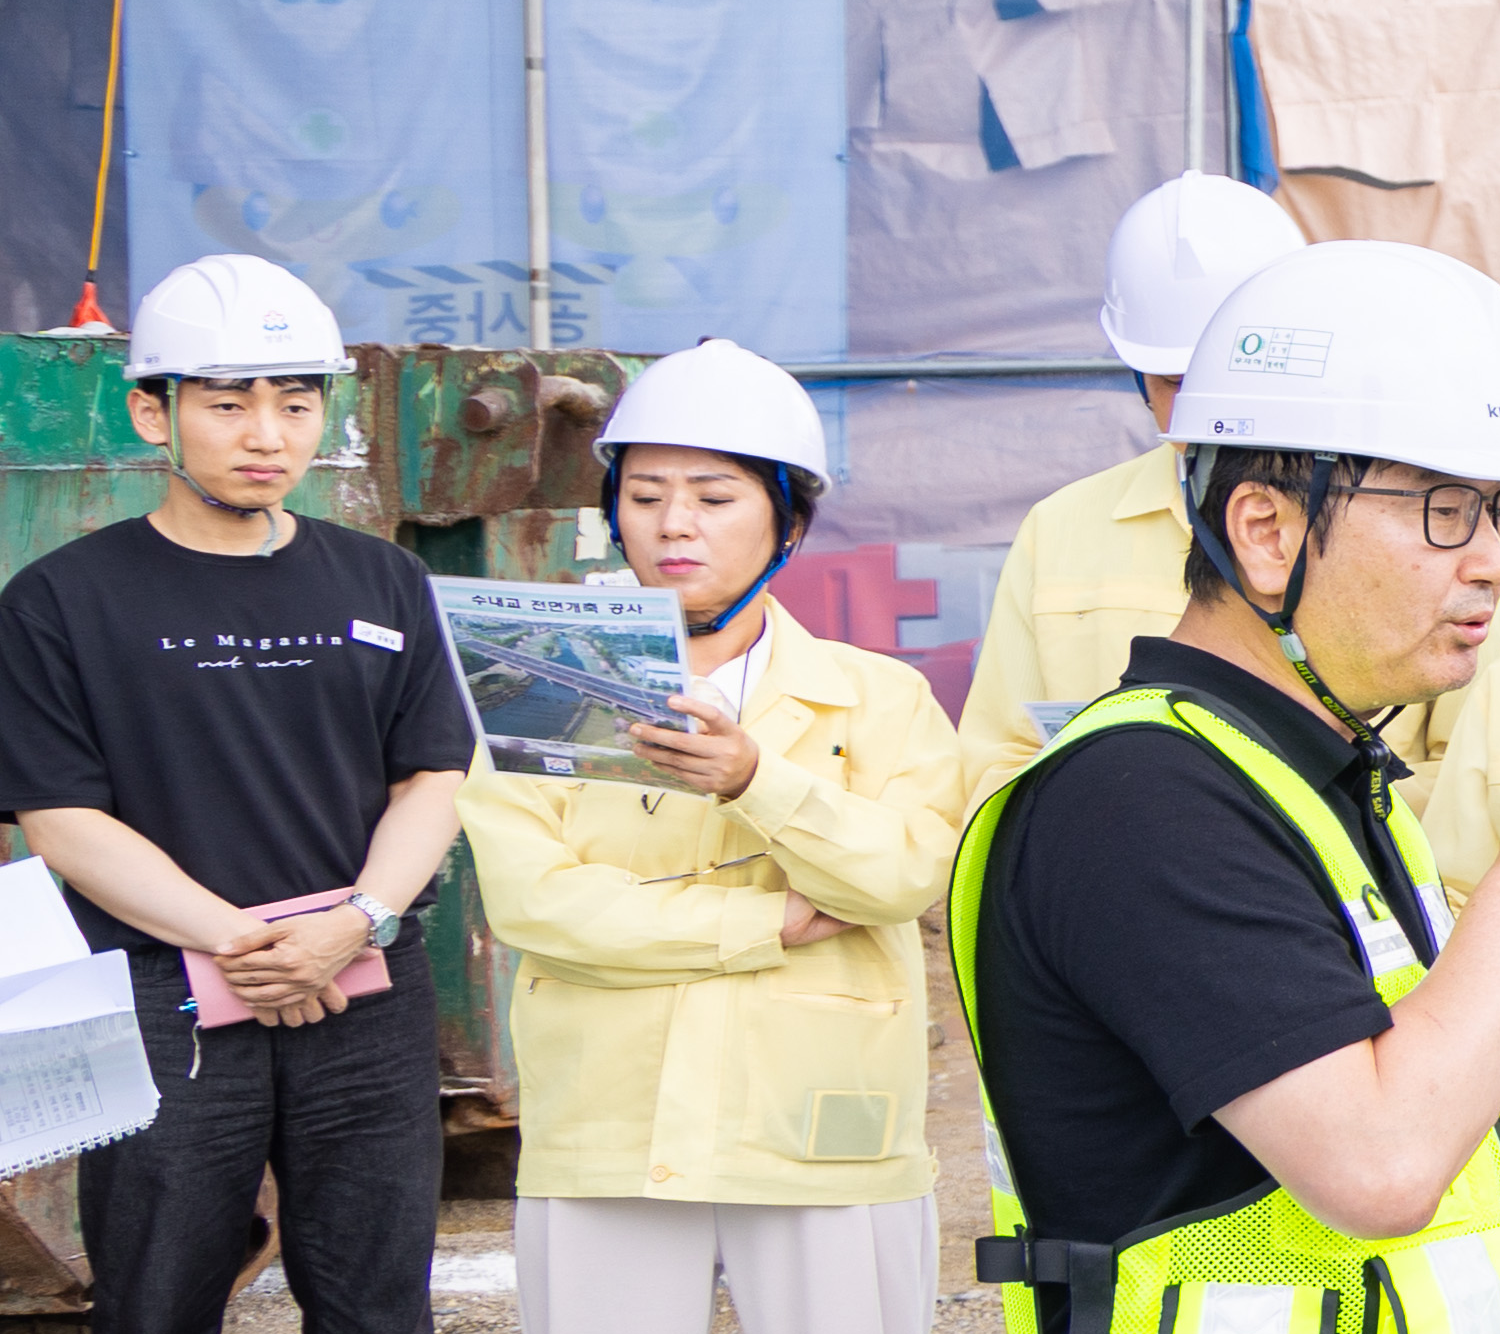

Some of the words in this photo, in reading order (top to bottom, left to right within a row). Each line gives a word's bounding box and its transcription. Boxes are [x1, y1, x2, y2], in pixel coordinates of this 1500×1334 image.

[472, 594, 521, 609] 수내교
[531, 599, 599, 614] 전면개축
[608, 602, 643, 615] 공사
[160, 637, 196, 650] Le
[216, 633, 343, 650] Magasin
